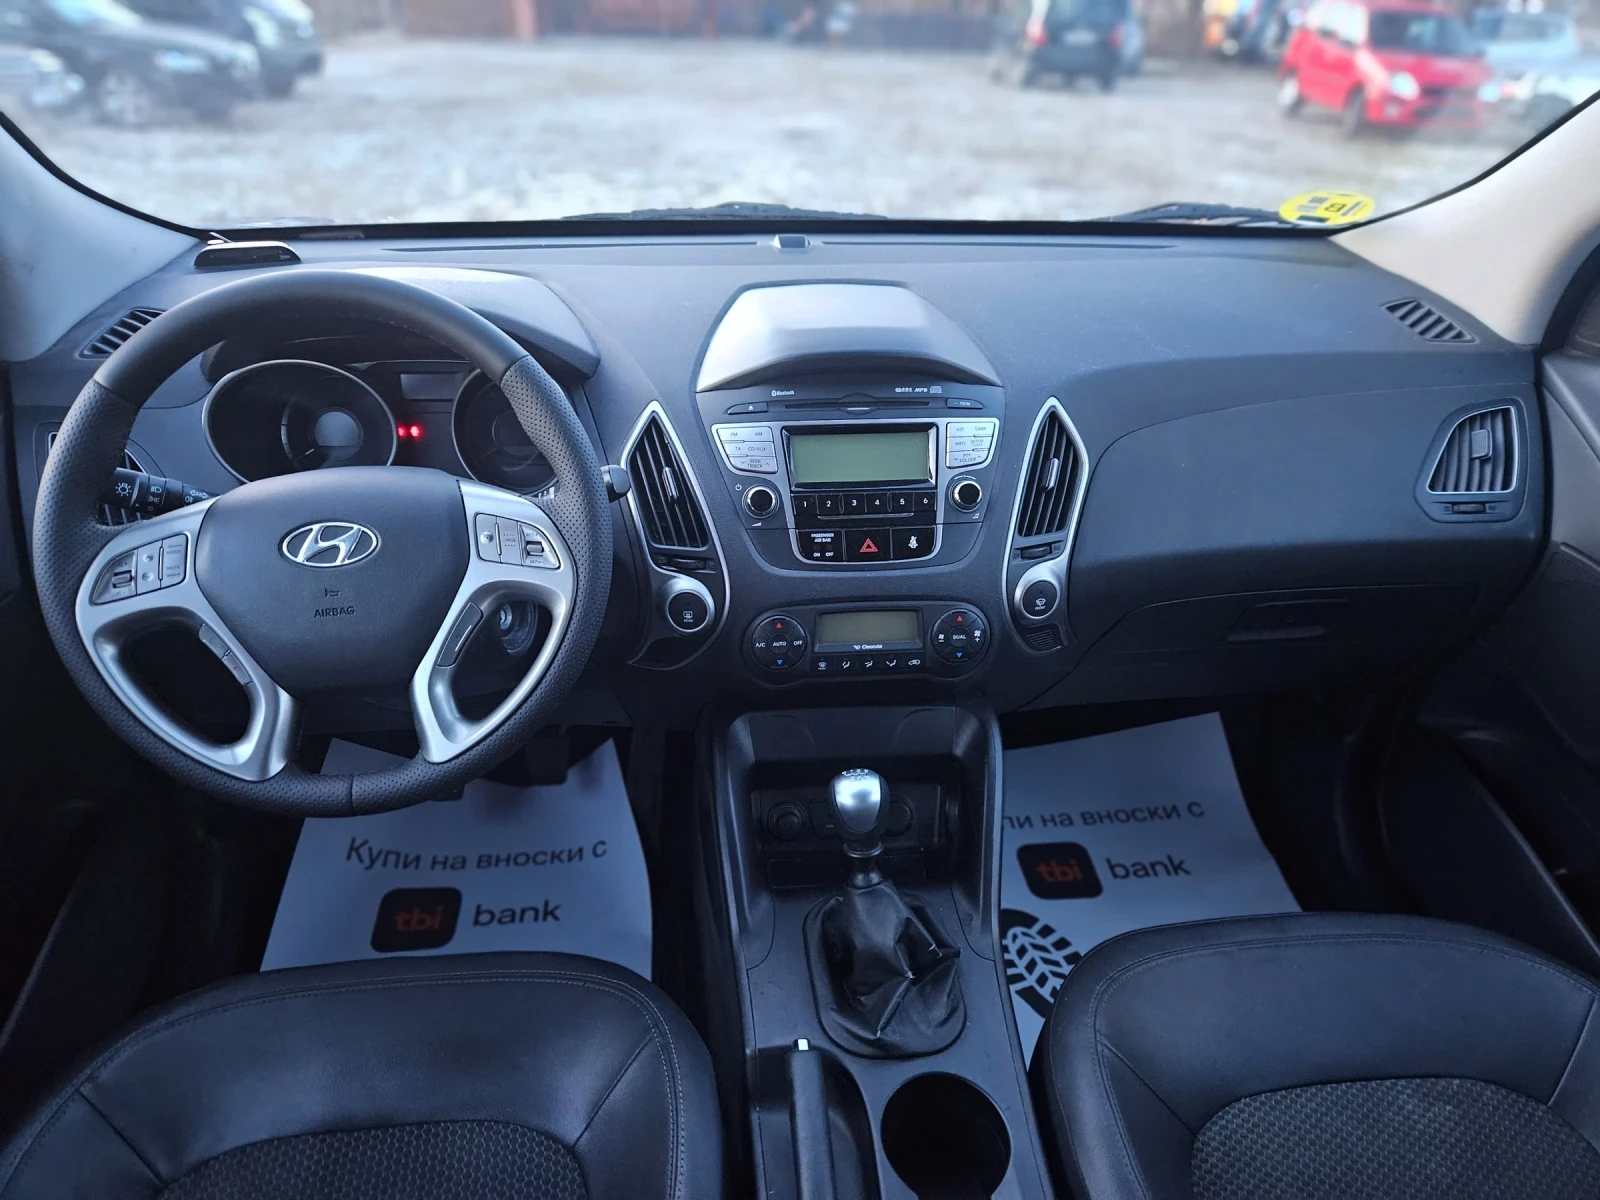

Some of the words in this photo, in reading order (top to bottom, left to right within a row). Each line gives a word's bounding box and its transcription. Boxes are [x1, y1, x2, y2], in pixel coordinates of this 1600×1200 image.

[314, 605, 355, 618] AIRBAG
[1041, 812, 1074, 828] на
[1081, 802, 1181, 827] вноски
[345, 836, 421, 871] Купи
[430, 852, 467, 872] на
[476, 847, 584, 869] вноски
[1035, 858, 1082, 882] tbi
[1105, 854, 1192, 880] bank
[393, 906, 445, 932] tbi
[472, 900, 562, 928] bank
